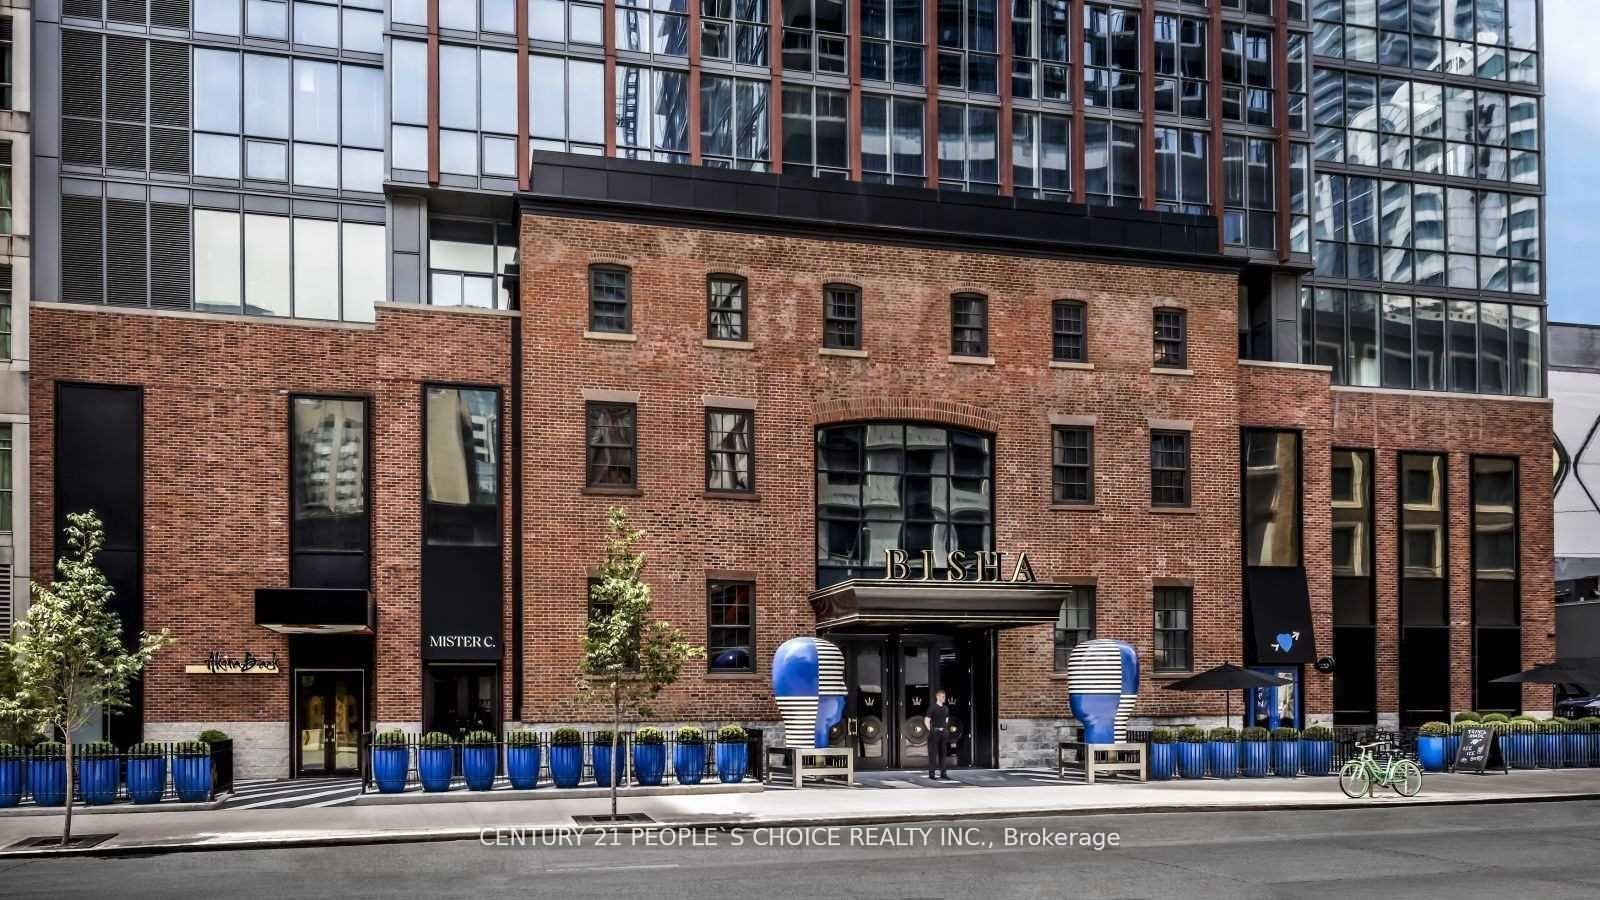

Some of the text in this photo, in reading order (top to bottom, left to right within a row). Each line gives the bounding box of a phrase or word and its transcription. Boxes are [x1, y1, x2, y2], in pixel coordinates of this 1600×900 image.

[884, 549, 1037, 583] BISHA
[430, 635, 496, 647] MISTER C.
